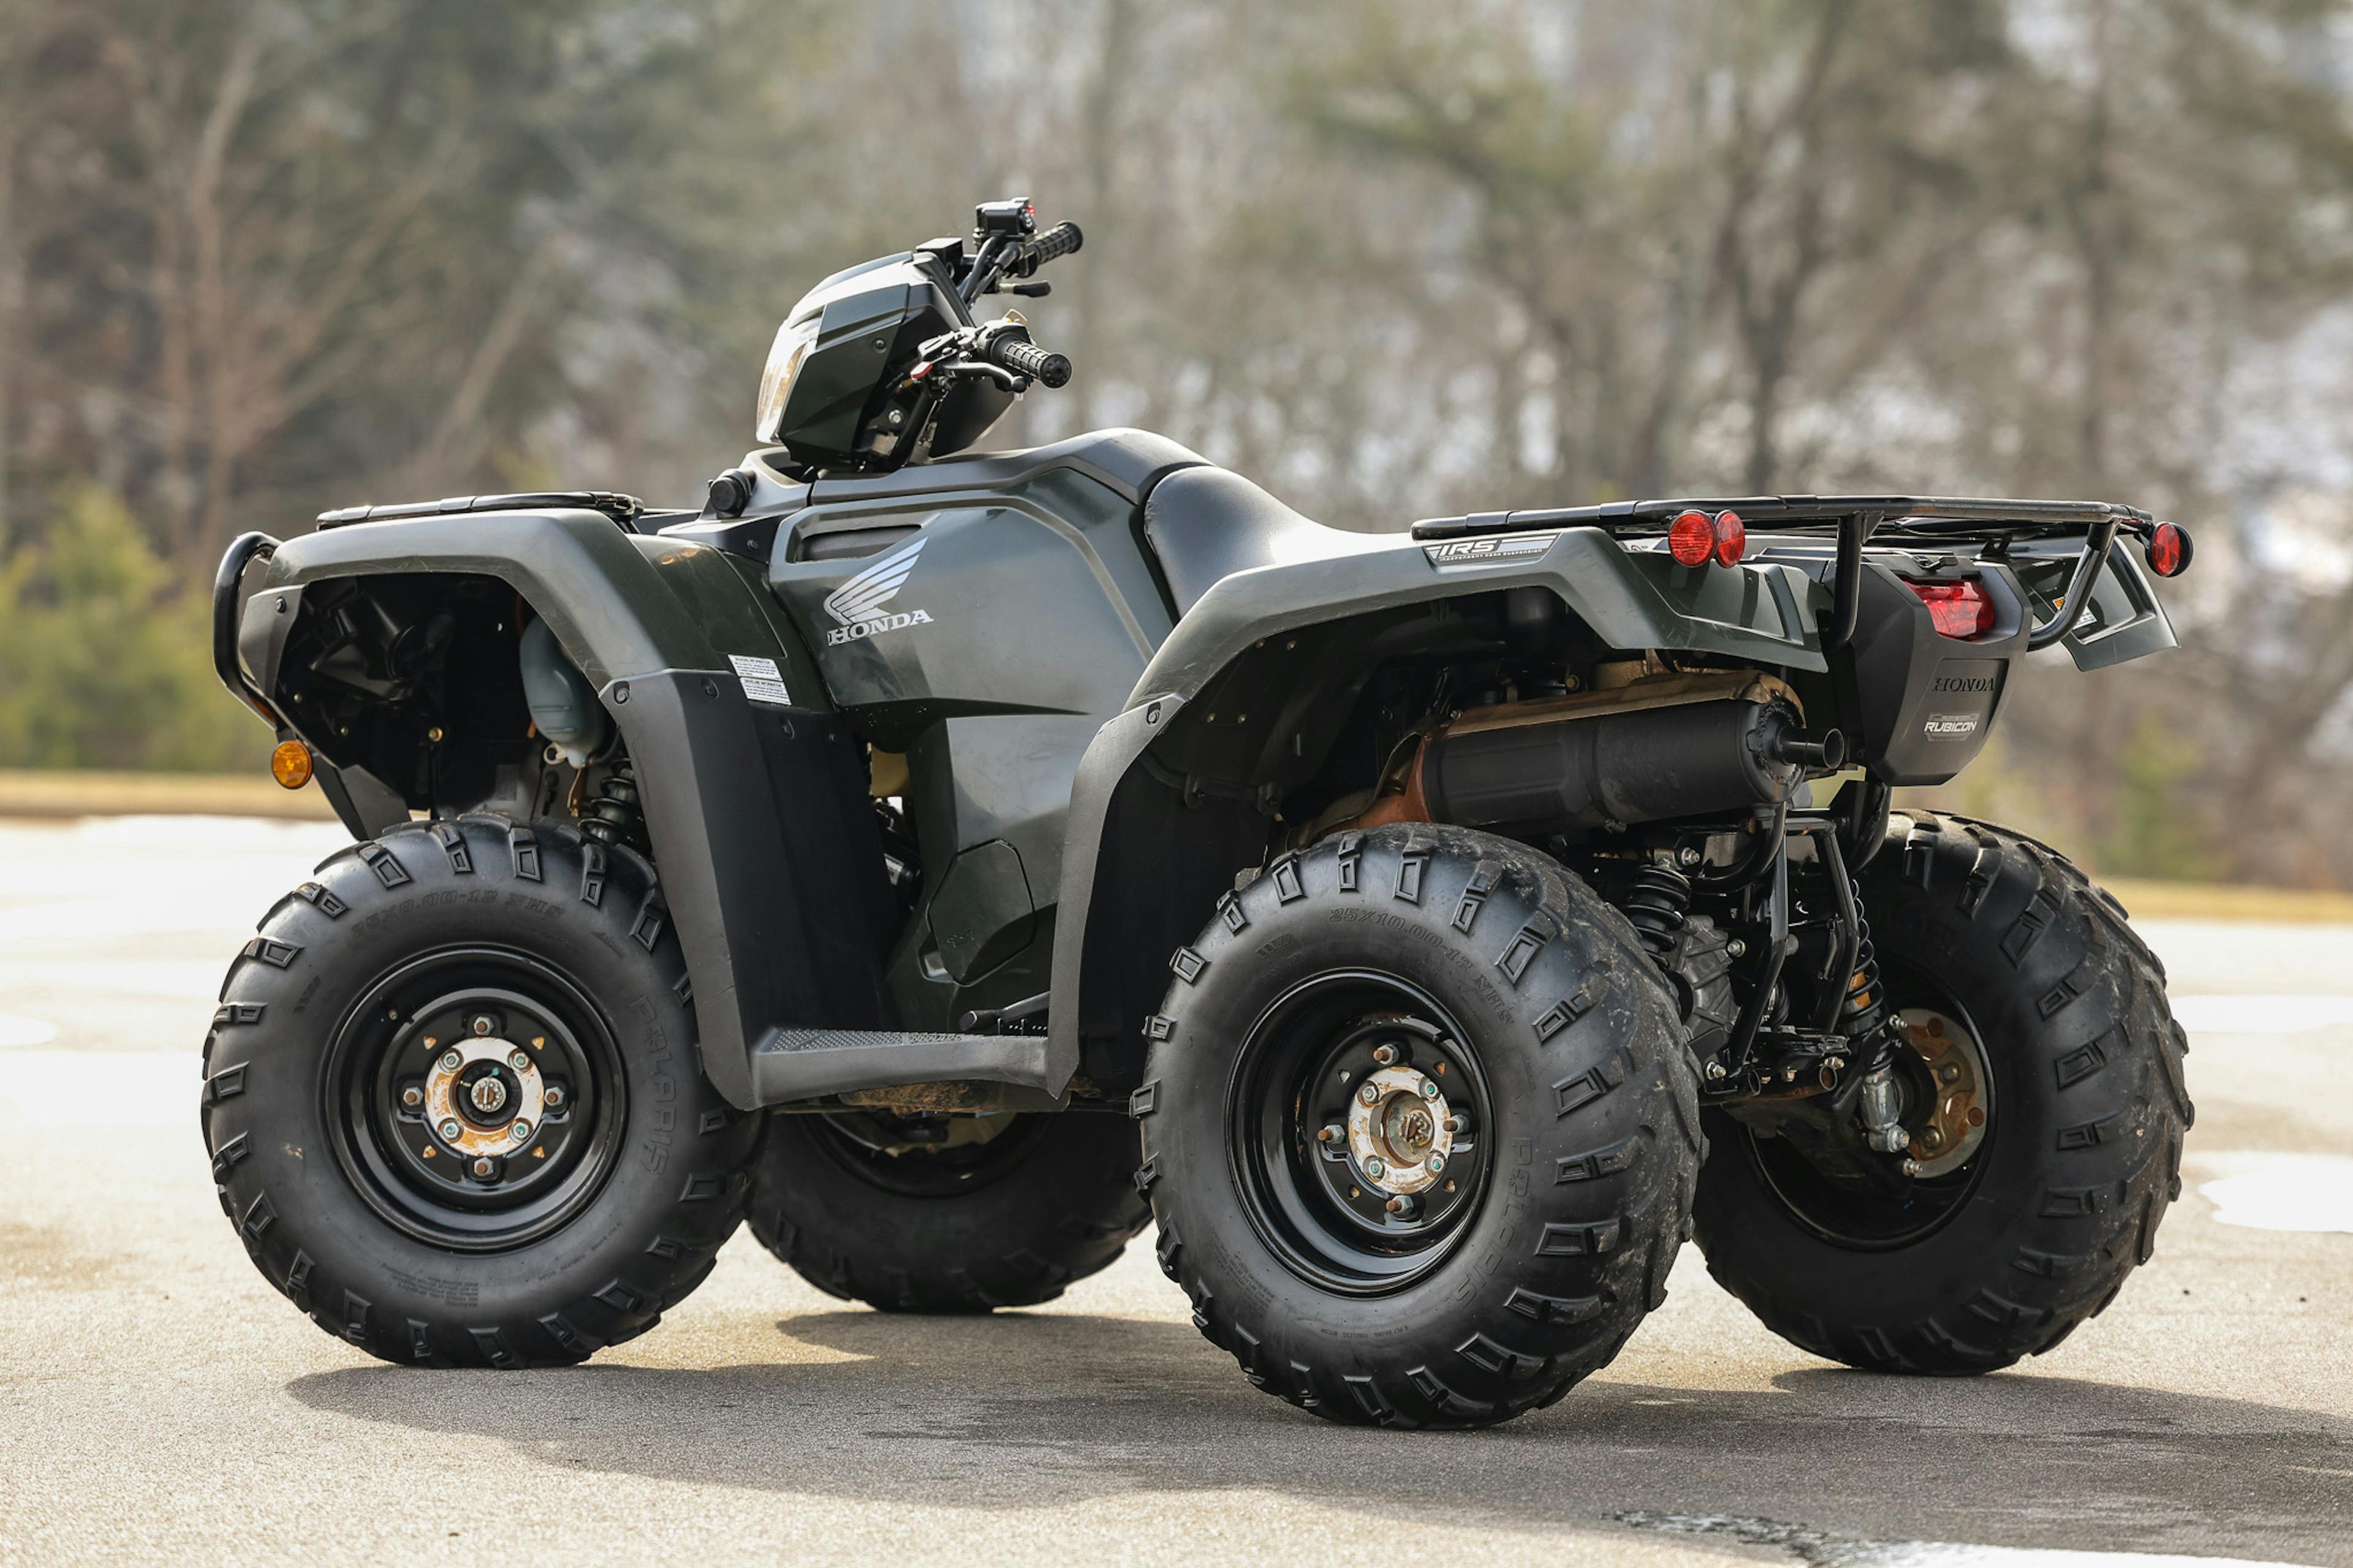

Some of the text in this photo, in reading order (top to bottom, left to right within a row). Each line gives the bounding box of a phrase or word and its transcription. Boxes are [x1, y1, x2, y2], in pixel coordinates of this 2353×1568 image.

[1439, 540, 1497, 556] IRS
[827, 608, 934, 646] HONDA
[1931, 678, 1995, 692] HONDA
[1924, 721, 1978, 733] RUBICON
